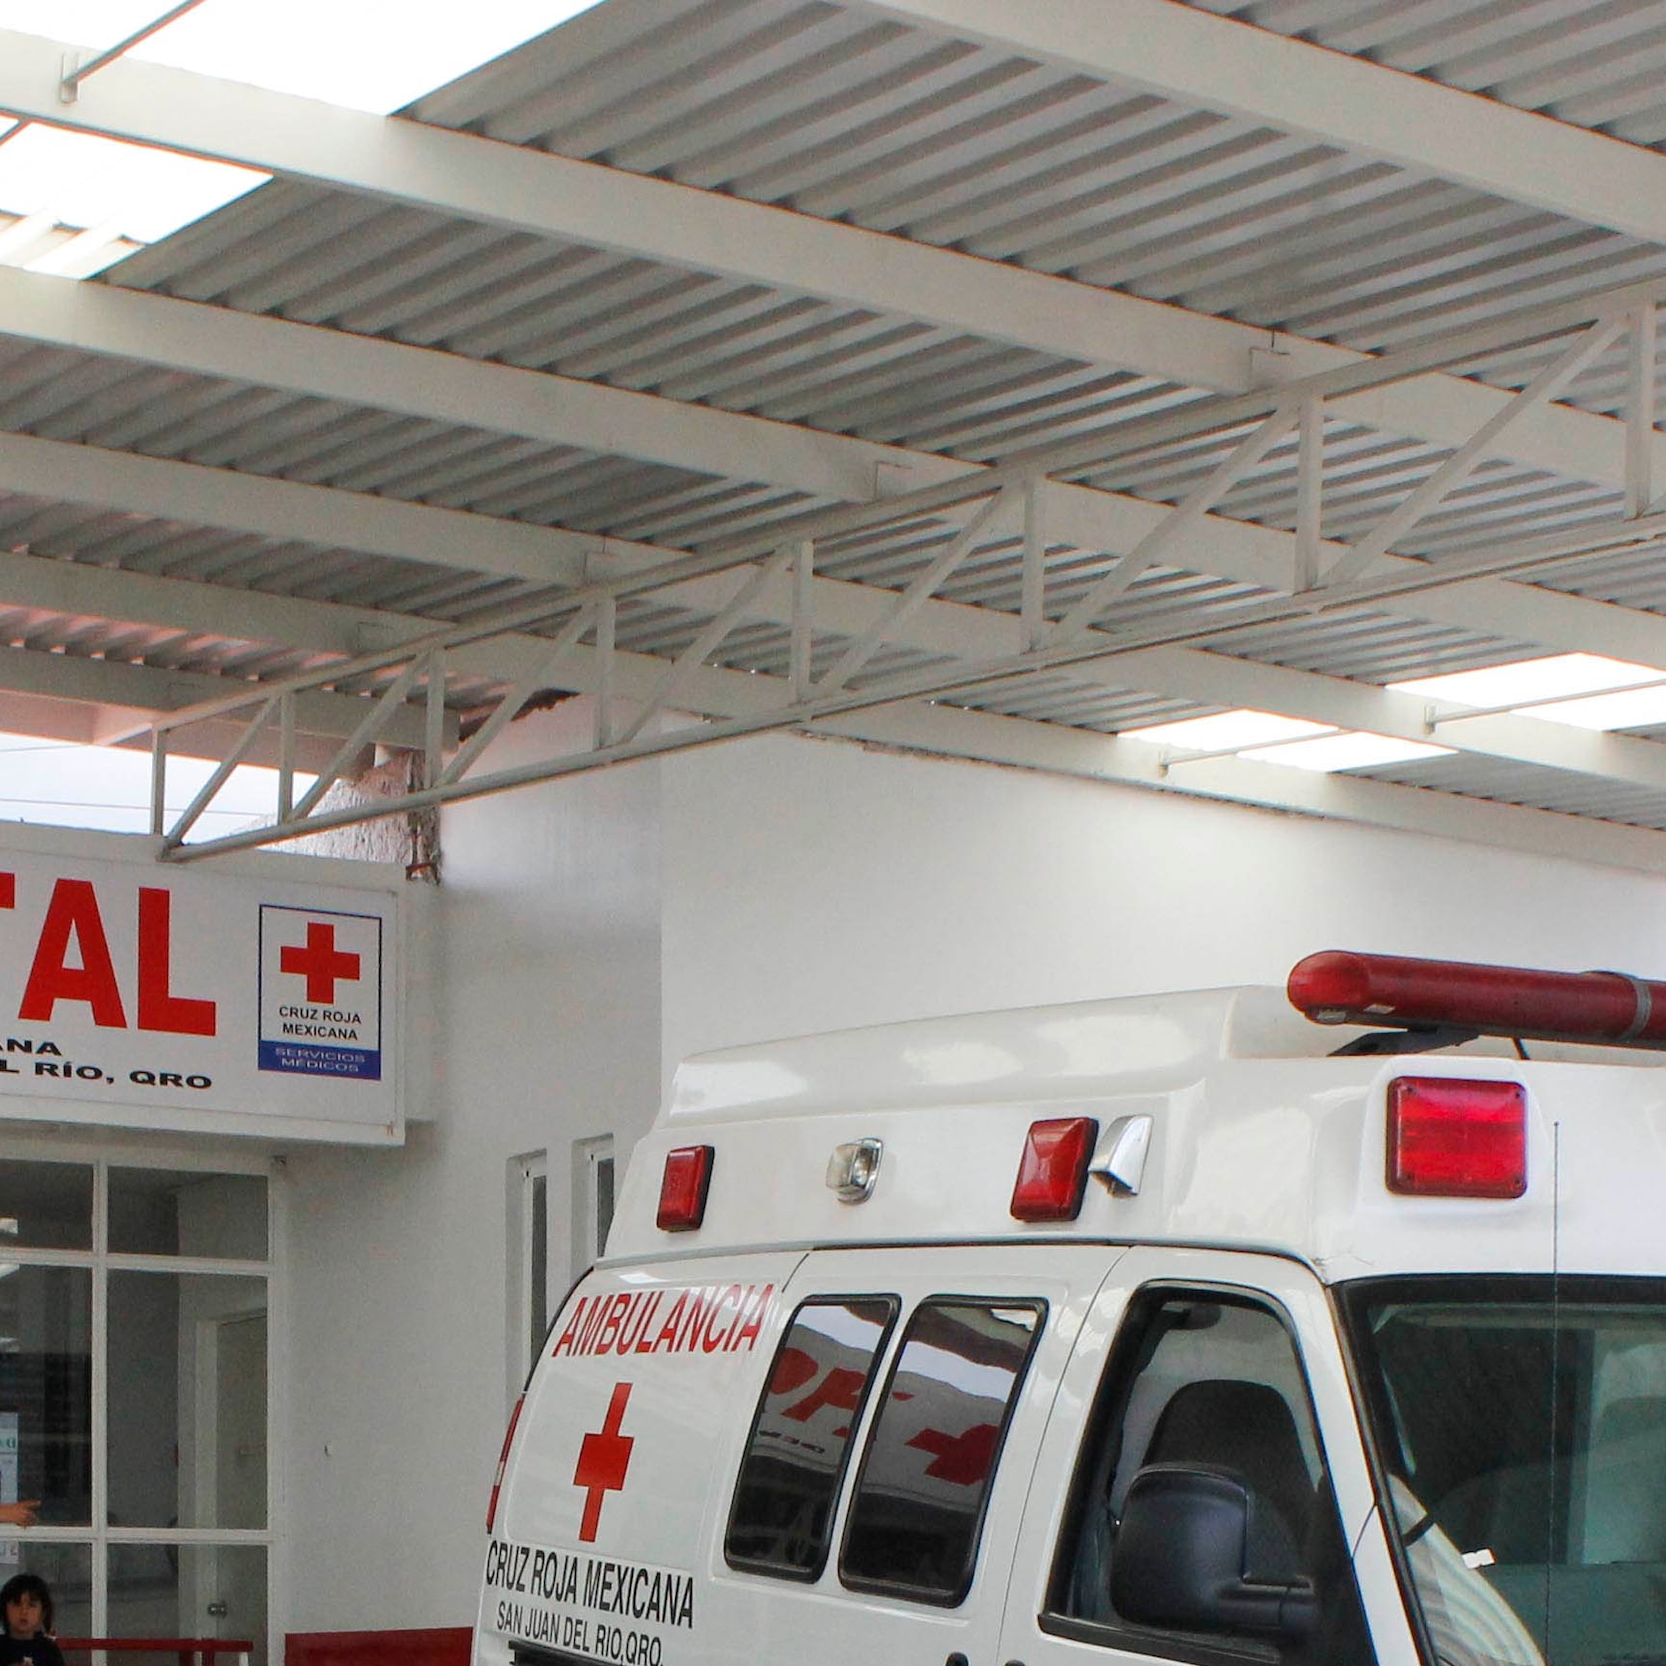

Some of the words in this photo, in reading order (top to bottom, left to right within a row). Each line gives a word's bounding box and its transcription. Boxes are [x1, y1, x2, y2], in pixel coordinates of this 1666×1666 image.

[279, 1006, 318, 1020] CRUZ
[323, 1011, 361, 1024] ROJA
[283, 1023, 358, 1040] MEXICANA
[276, 1047, 365, 1063] SERVICIOS
[34, 1062, 115, 1084] RÍO,
[129, 1070, 213, 1090] QRO
[551, 1283, 774, 1357] AMBULANCIA
[486, 1540, 529, 1592] CRUZ
[533, 1550, 577, 1605] ROJA
[583, 1559, 693, 1629] MEXICANA
[497, 1601, 522, 1634] SAN
[524, 1610, 560, 1645] JUAN
[563, 1618, 592, 1653] DEL
